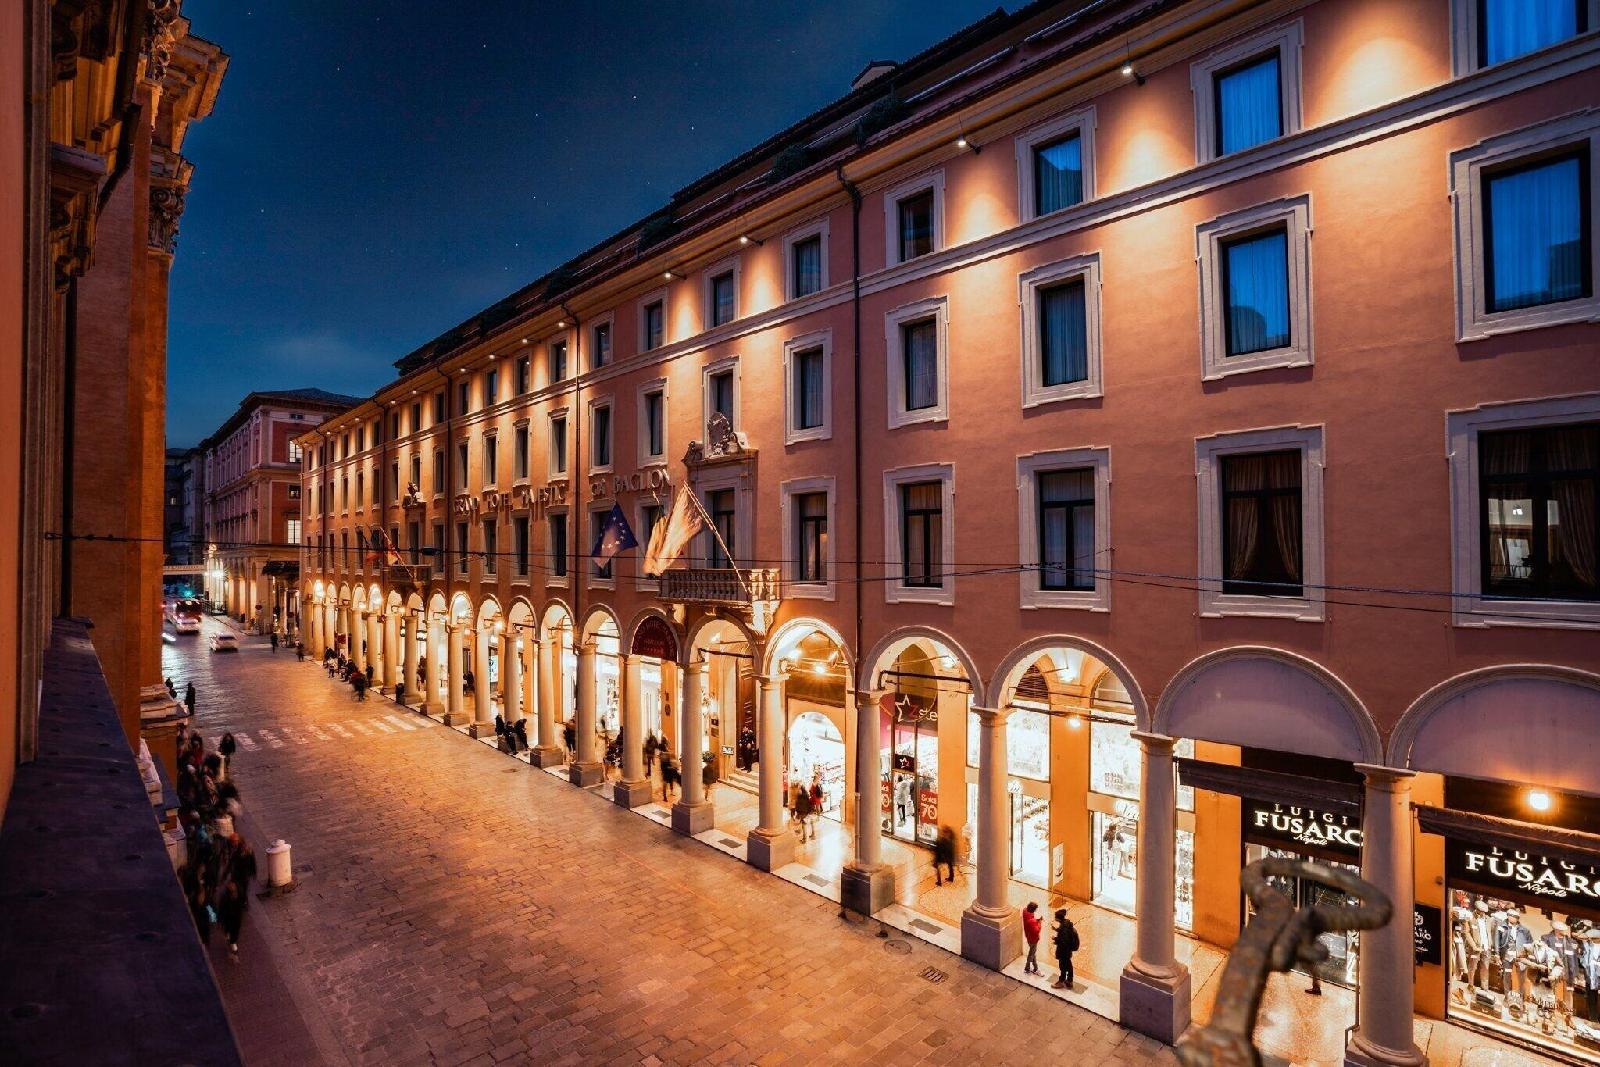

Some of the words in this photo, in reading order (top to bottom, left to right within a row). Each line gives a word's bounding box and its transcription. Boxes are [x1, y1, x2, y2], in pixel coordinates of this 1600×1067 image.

[1274, 803, 1348, 826] LUIGI
[1293, 833, 1328, 846] Napoli
[1492, 846, 1595, 875] LUIGI
[1465, 851, 1600, 898] FUSAR
[1518, 882, 1568, 898] Napoli
